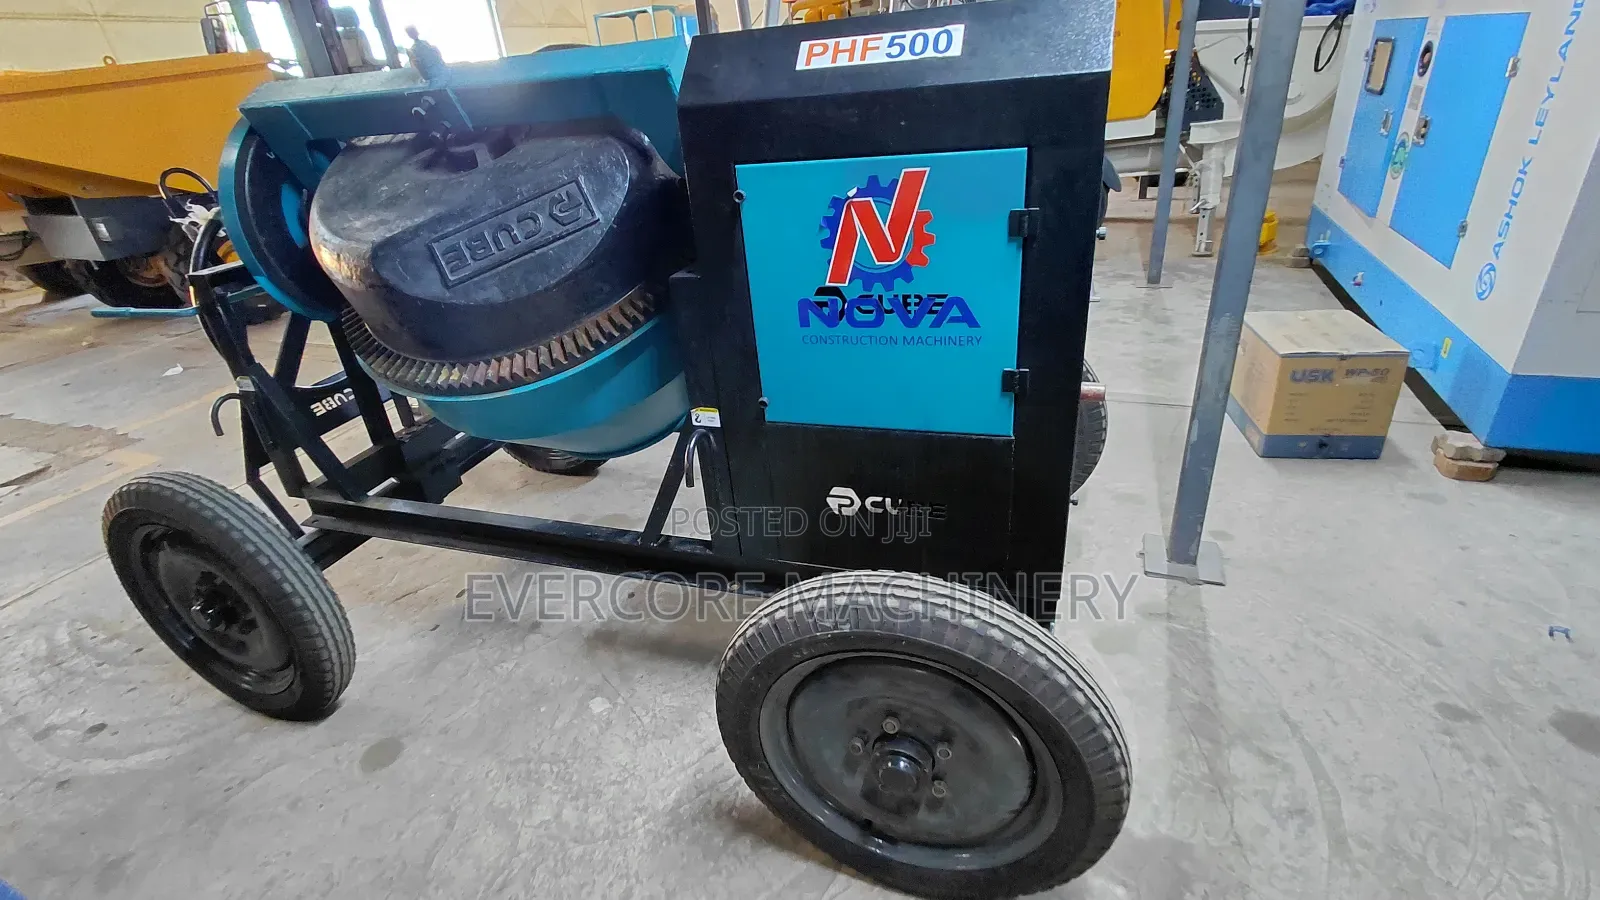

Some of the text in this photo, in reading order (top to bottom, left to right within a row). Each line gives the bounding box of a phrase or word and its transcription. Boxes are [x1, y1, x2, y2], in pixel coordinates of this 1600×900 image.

[805, 29, 953, 66] PHF500
[1493, 156, 1533, 260] ASHOK
[443, 211, 544, 274] CUBE
[798, 296, 982, 329] NOVA
[802, 334, 983, 348] CONSTRUCTION MACHINERY
[1289, 368, 1335, 384] USK
[310, 387, 355, 417] CUBE
